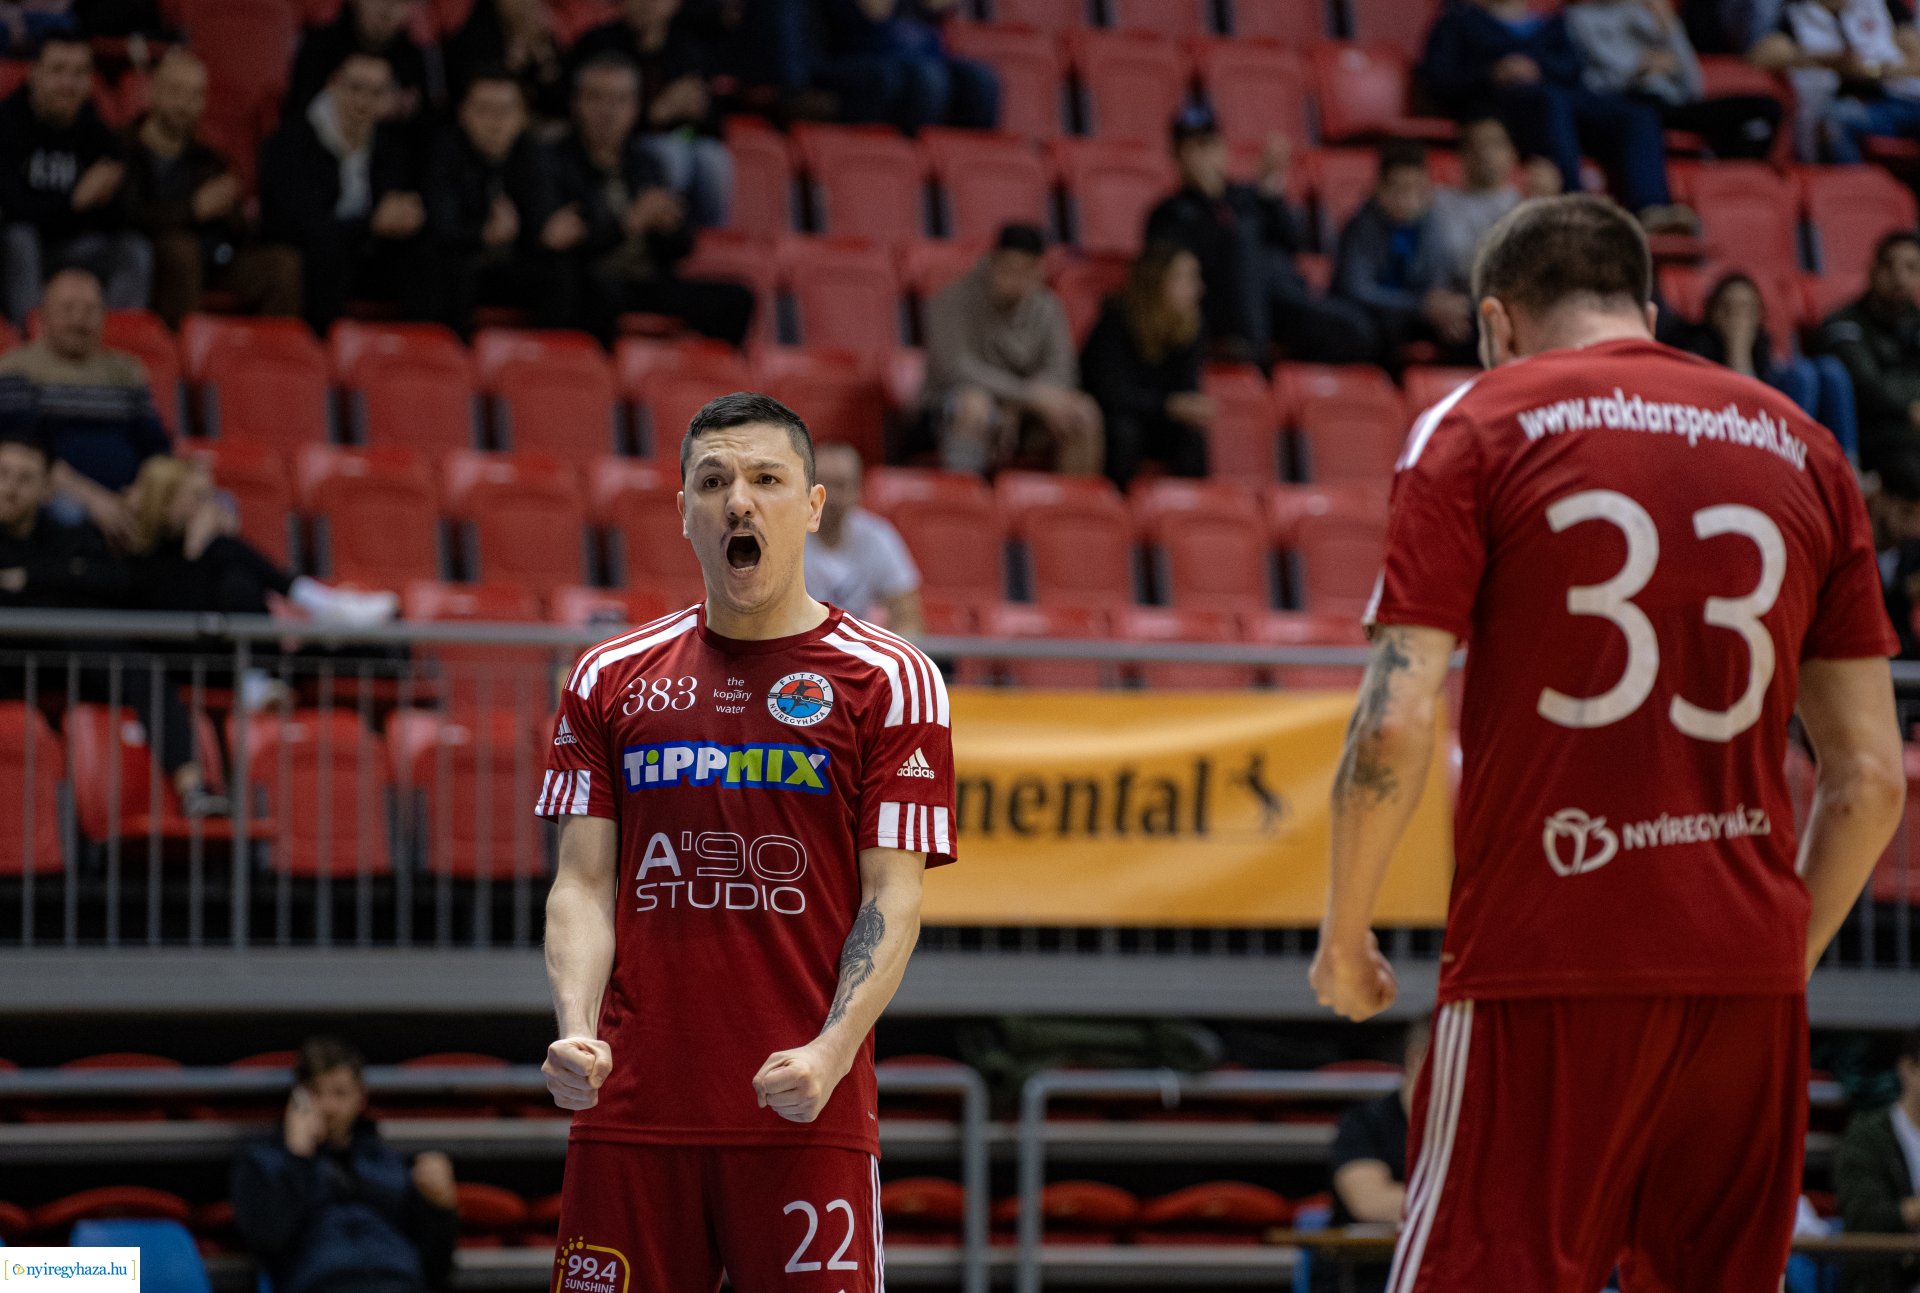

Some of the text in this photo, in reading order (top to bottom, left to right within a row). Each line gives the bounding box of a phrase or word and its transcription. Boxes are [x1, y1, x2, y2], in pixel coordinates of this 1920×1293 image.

[1536, 488, 1787, 743] 33
[622, 675, 698, 716] 383
[727, 677, 745, 686] the
[780, 673, 829, 691] FUTSAL
[715, 705, 746, 714] water
[896, 765, 935, 780] adidas
[955, 754, 1209, 838] nental
[635, 831, 808, 882] A'90
[636, 880, 806, 915] STUDIO
[783, 1199, 859, 1273] 22
[568, 1254, 617, 1283] 99.4
[565, 1278, 615, 1293] SUNSHINE
